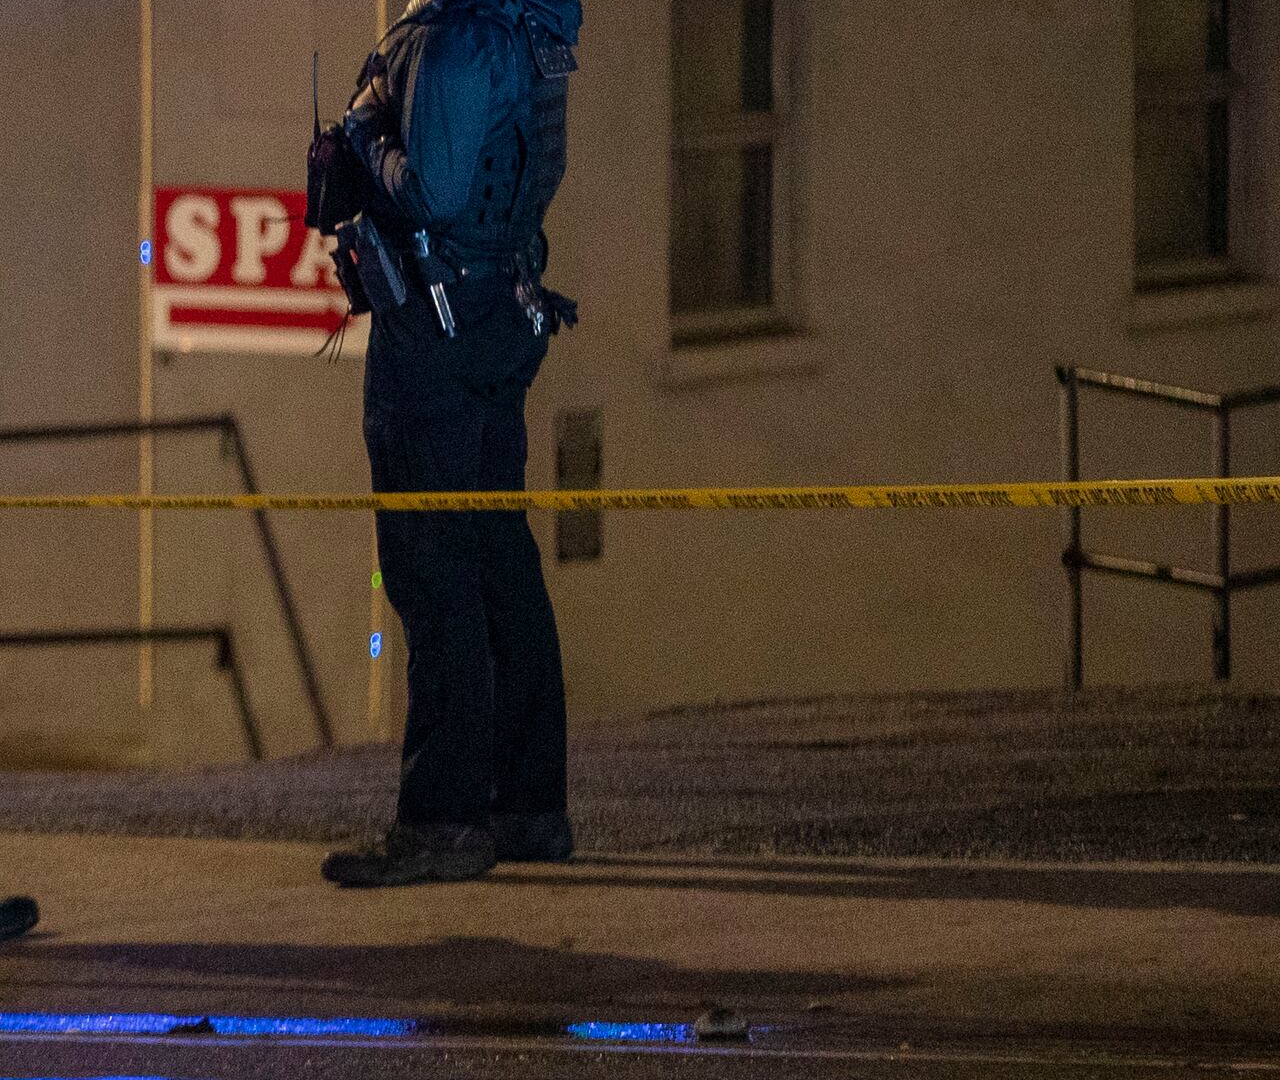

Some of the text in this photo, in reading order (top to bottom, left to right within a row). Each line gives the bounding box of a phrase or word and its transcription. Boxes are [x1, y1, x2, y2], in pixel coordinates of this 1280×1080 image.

[163, 194, 342, 288] SPA
[886, 491, 1014, 507] POLICE LINE DO NOT CROSS
[1048, 487, 1180, 505] POLICE LINE DO NOT CROSS
